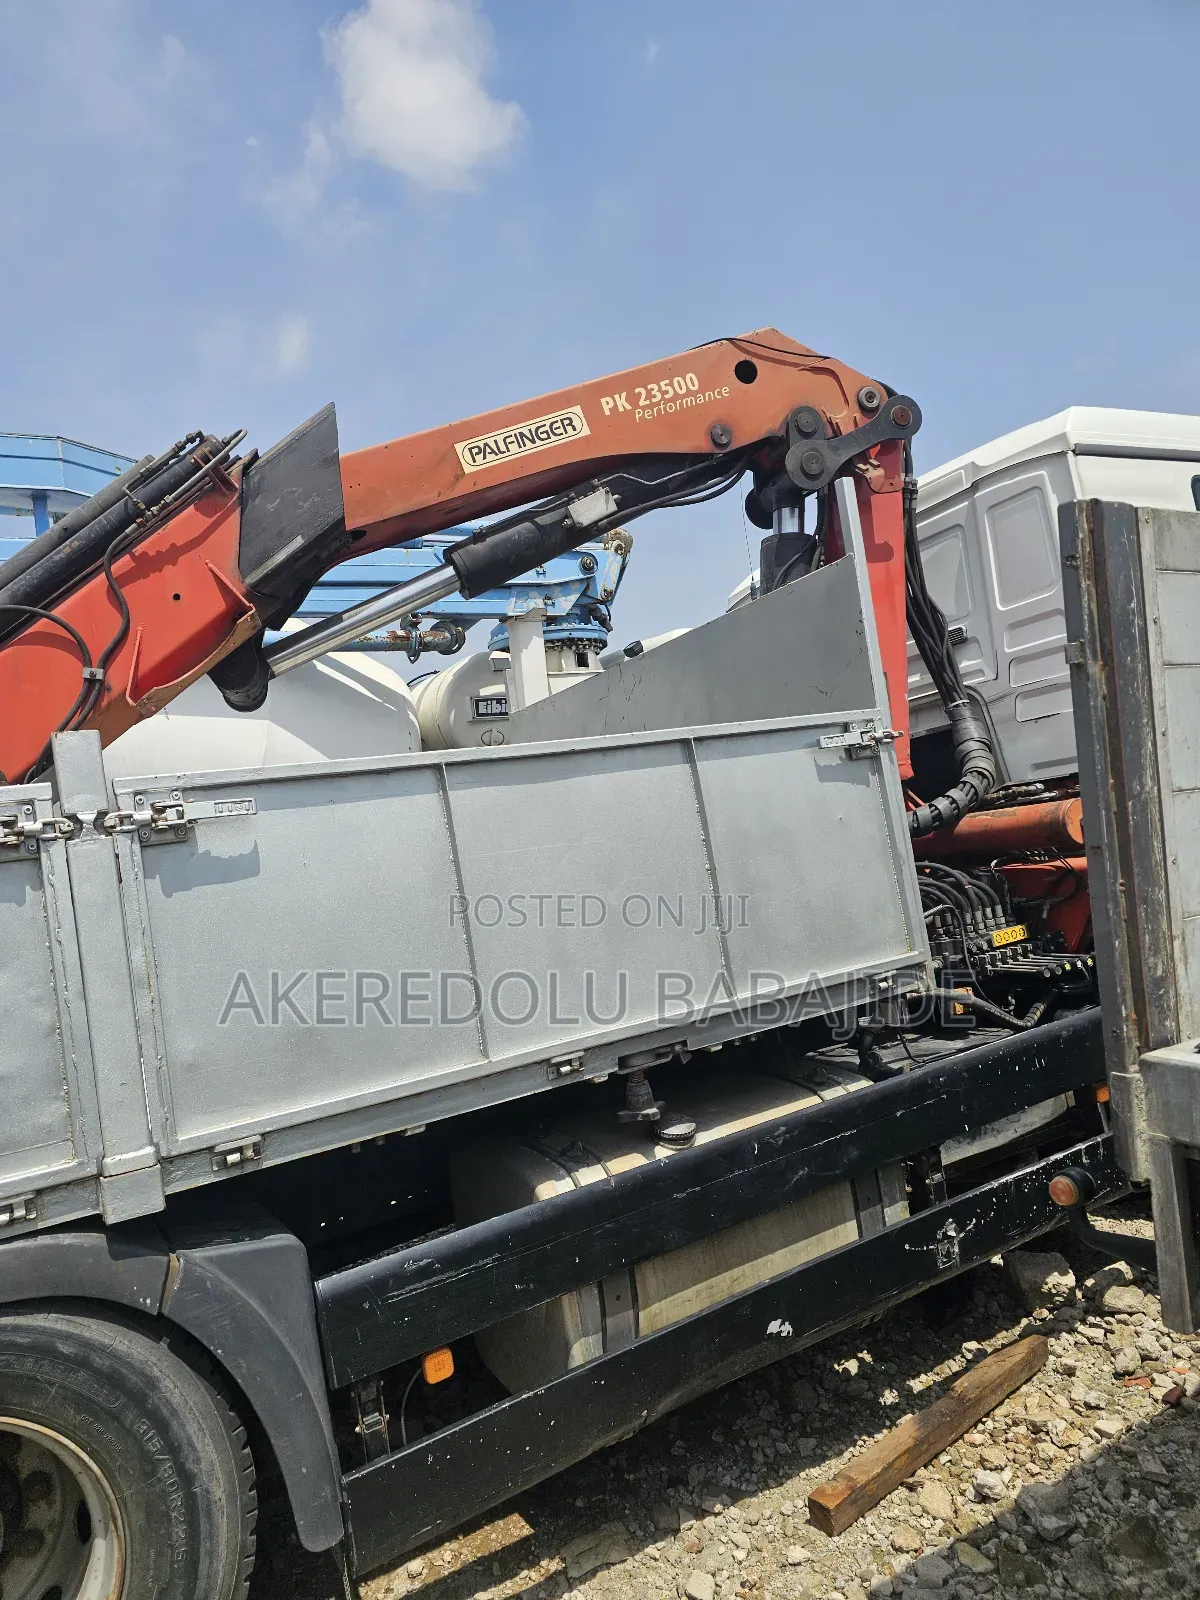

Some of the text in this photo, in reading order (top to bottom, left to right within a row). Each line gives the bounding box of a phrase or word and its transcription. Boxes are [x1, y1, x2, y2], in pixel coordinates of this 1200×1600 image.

[600, 372, 699, 415] PK 23500
[635, 386, 730, 422] Performance
[467, 415, 577, 464] PALFINGER
